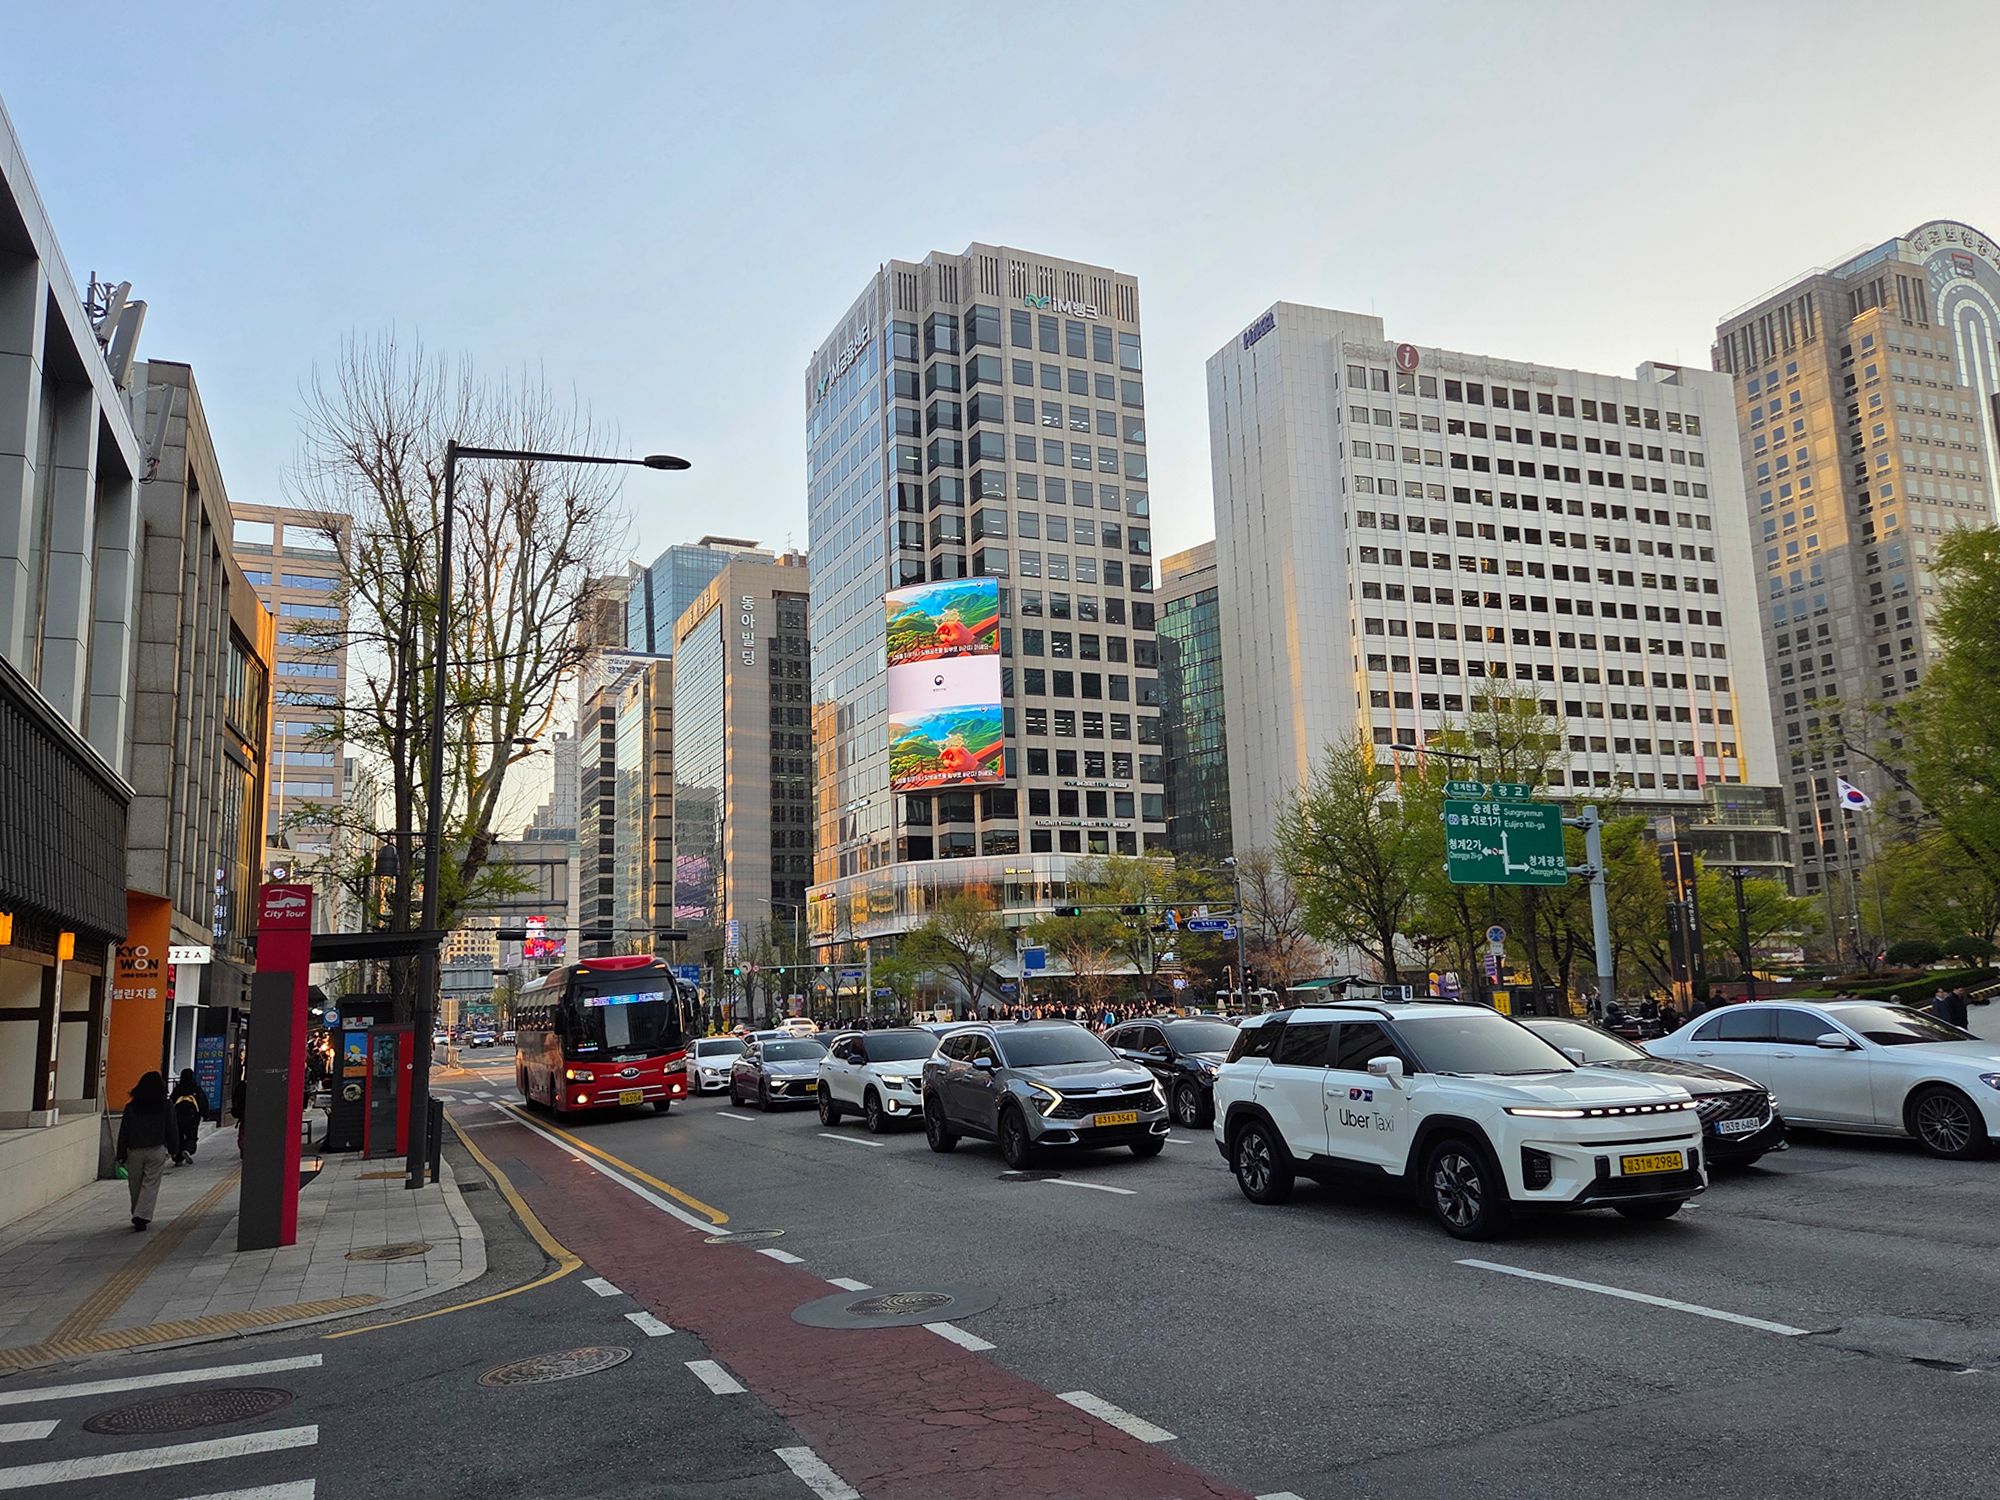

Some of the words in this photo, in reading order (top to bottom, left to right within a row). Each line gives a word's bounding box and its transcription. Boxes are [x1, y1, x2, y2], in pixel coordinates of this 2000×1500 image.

[1053, 296, 1098, 320] iM뱅크
[741, 595, 756, 666] 동아빌딩
[1503, 808, 1544, 818] Sungnyemun
[1461, 815, 1501, 827] 을지로1가
[1449, 838, 1482, 851] 청계2가
[1529, 855, 1565, 868] 청계광장
[264, 910, 283, 920] City
[286, 910, 306, 918] Tour
[116, 945, 149, 957] KYO
[121, 959, 159, 970] WON
[113, 987, 158, 1000] 챌린지홀
[1339, 1108, 1370, 1129] Uber
[1372, 1111, 1395, 1132] Taxi
[1741, 1119, 1759, 1132] 6484
[1655, 1156, 1679, 1169] 2984
